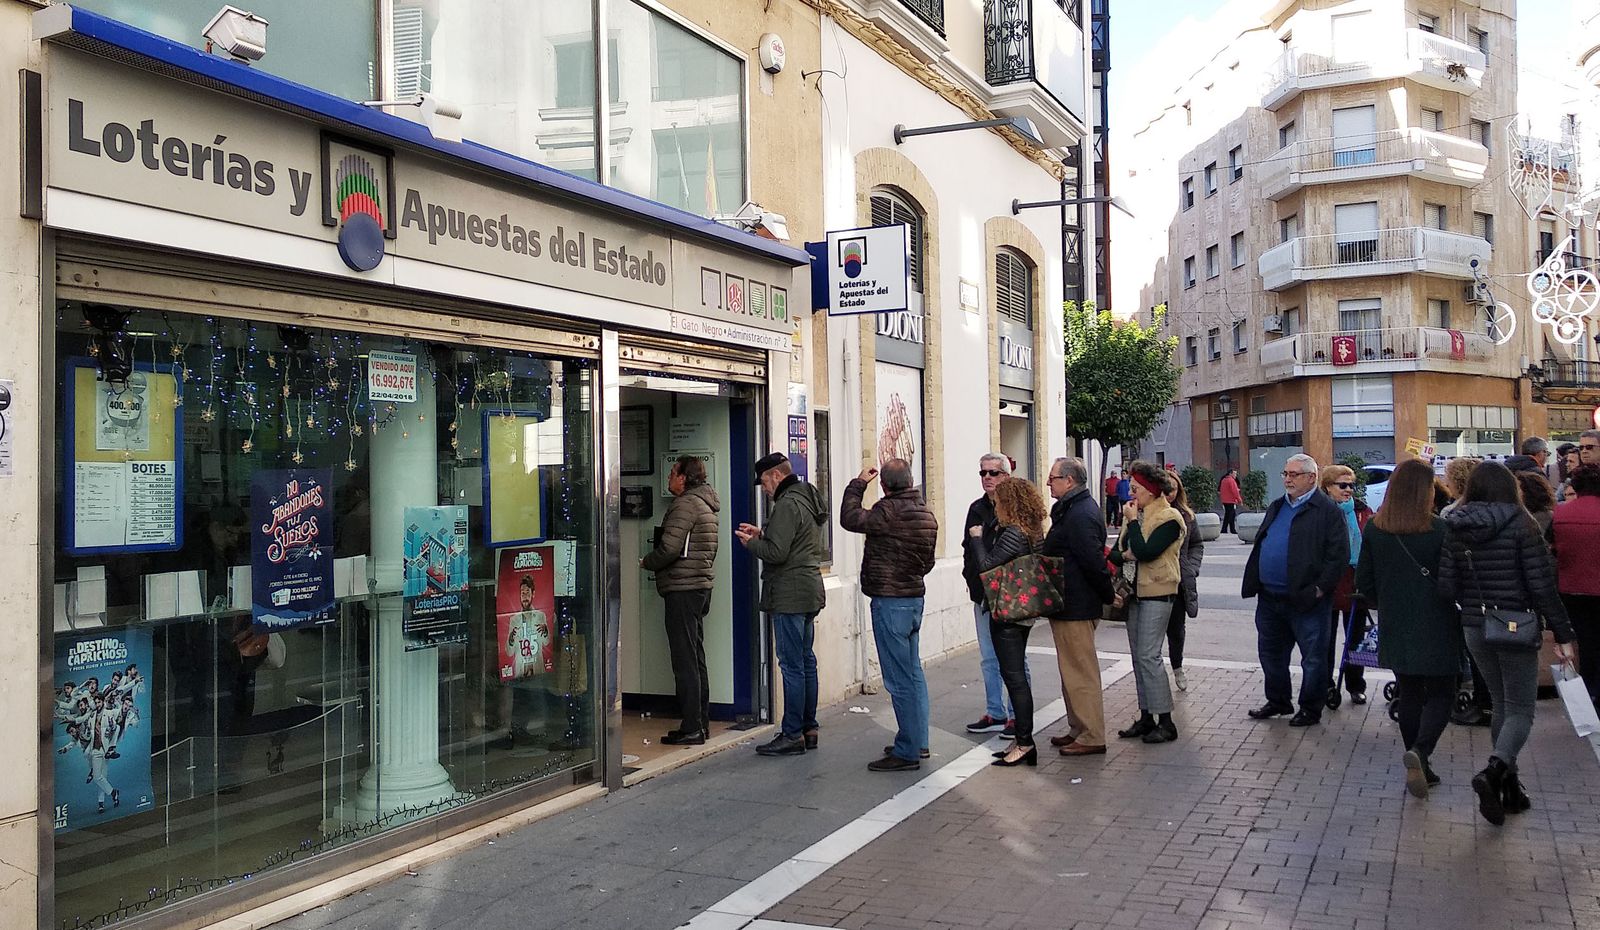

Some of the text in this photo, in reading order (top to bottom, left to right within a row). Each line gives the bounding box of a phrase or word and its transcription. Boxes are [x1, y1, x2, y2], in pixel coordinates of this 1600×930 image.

[68, 98, 312, 216] Loterías y
[401, 188, 666, 287] Apuestas del Estado
[839, 279, 877, 289] Loterías y
[839, 286, 889, 300] Apuestas del
[839, 298, 866, 308] Estado
[671, 316, 678, 329] El
[681, 318, 699, 332] Gato
[702, 322, 723, 339] Negro
[727, 326, 773, 345] Administración
[783, 337, 788, 348] 2
[878, 312, 925, 344] DIONI
[1004, 334, 1032, 371] DIONI
[371, 361, 399, 372] VENDIDO
[371, 373, 414, 391] 16.992,67€
[371, 391, 413, 400] 22/04/2018
[109, 401, 140, 411] 400.00
[131, 463, 166, 474] BOTES
[286, 479, 299, 499] NO
[262, 485, 323, 534] ABANDONES
[286, 513, 302, 528] TUS
[267, 516, 319, 563] SUEÑOS
[69, 648, 77, 656] EL
[76, 638, 119, 654] DESTINO
[67, 648, 128, 667] CAPRICHOSO
